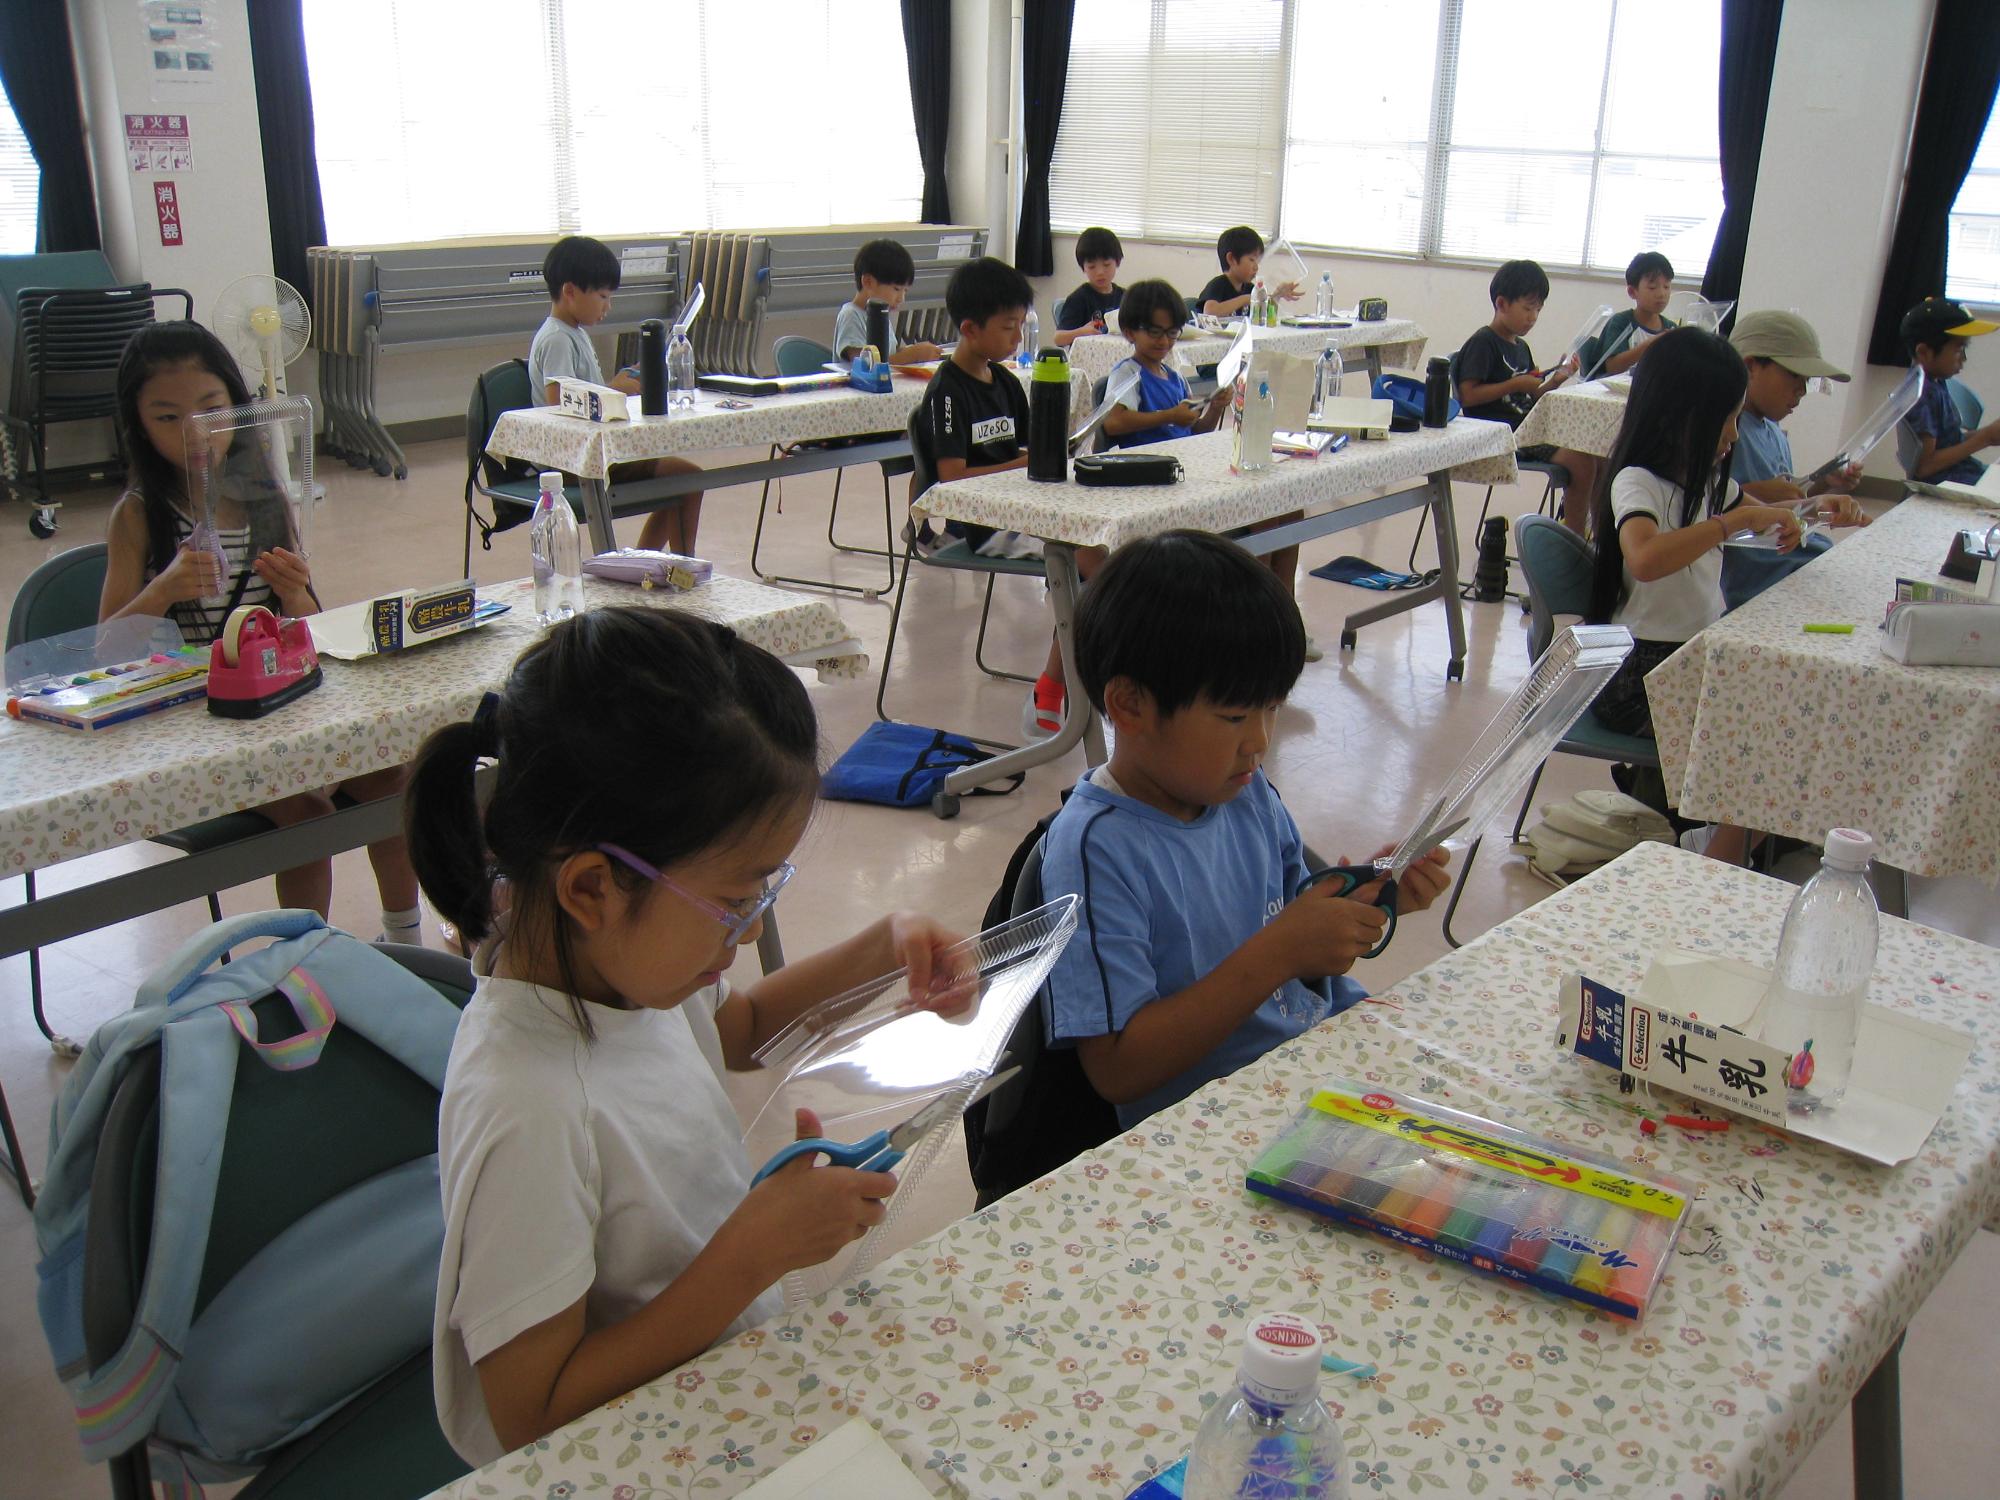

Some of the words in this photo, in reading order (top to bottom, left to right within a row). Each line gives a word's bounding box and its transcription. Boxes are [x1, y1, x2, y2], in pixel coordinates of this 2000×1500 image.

[132, 116, 181, 129] 消火器
[158, 187, 179, 239] 消火器
[1595, 1005, 1615, 1042] 牛乳
[1660, 1034, 1768, 1098] 牛乳
[1259, 1328, 1313, 1345] WILKINSON
